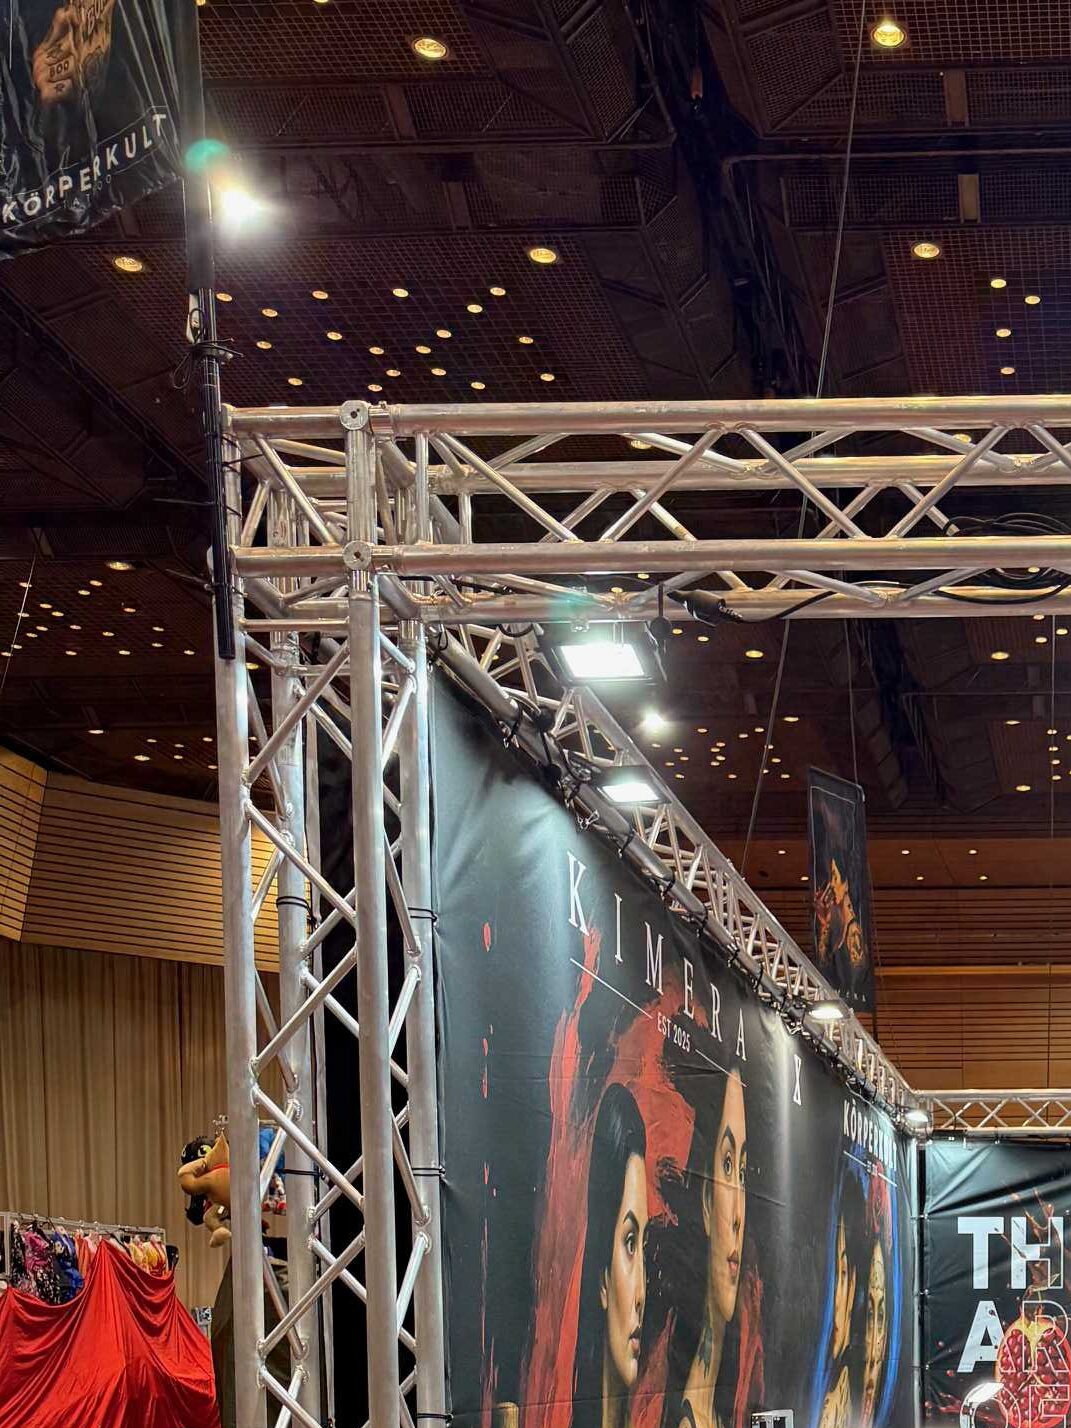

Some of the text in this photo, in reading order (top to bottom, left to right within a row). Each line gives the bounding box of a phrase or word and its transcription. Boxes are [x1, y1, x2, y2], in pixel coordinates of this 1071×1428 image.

[2, 114, 167, 224] KÖRPERKULT
[566, 851, 747, 1061] KIMERA
[657, 1012, 691, 1053] EST 2025
